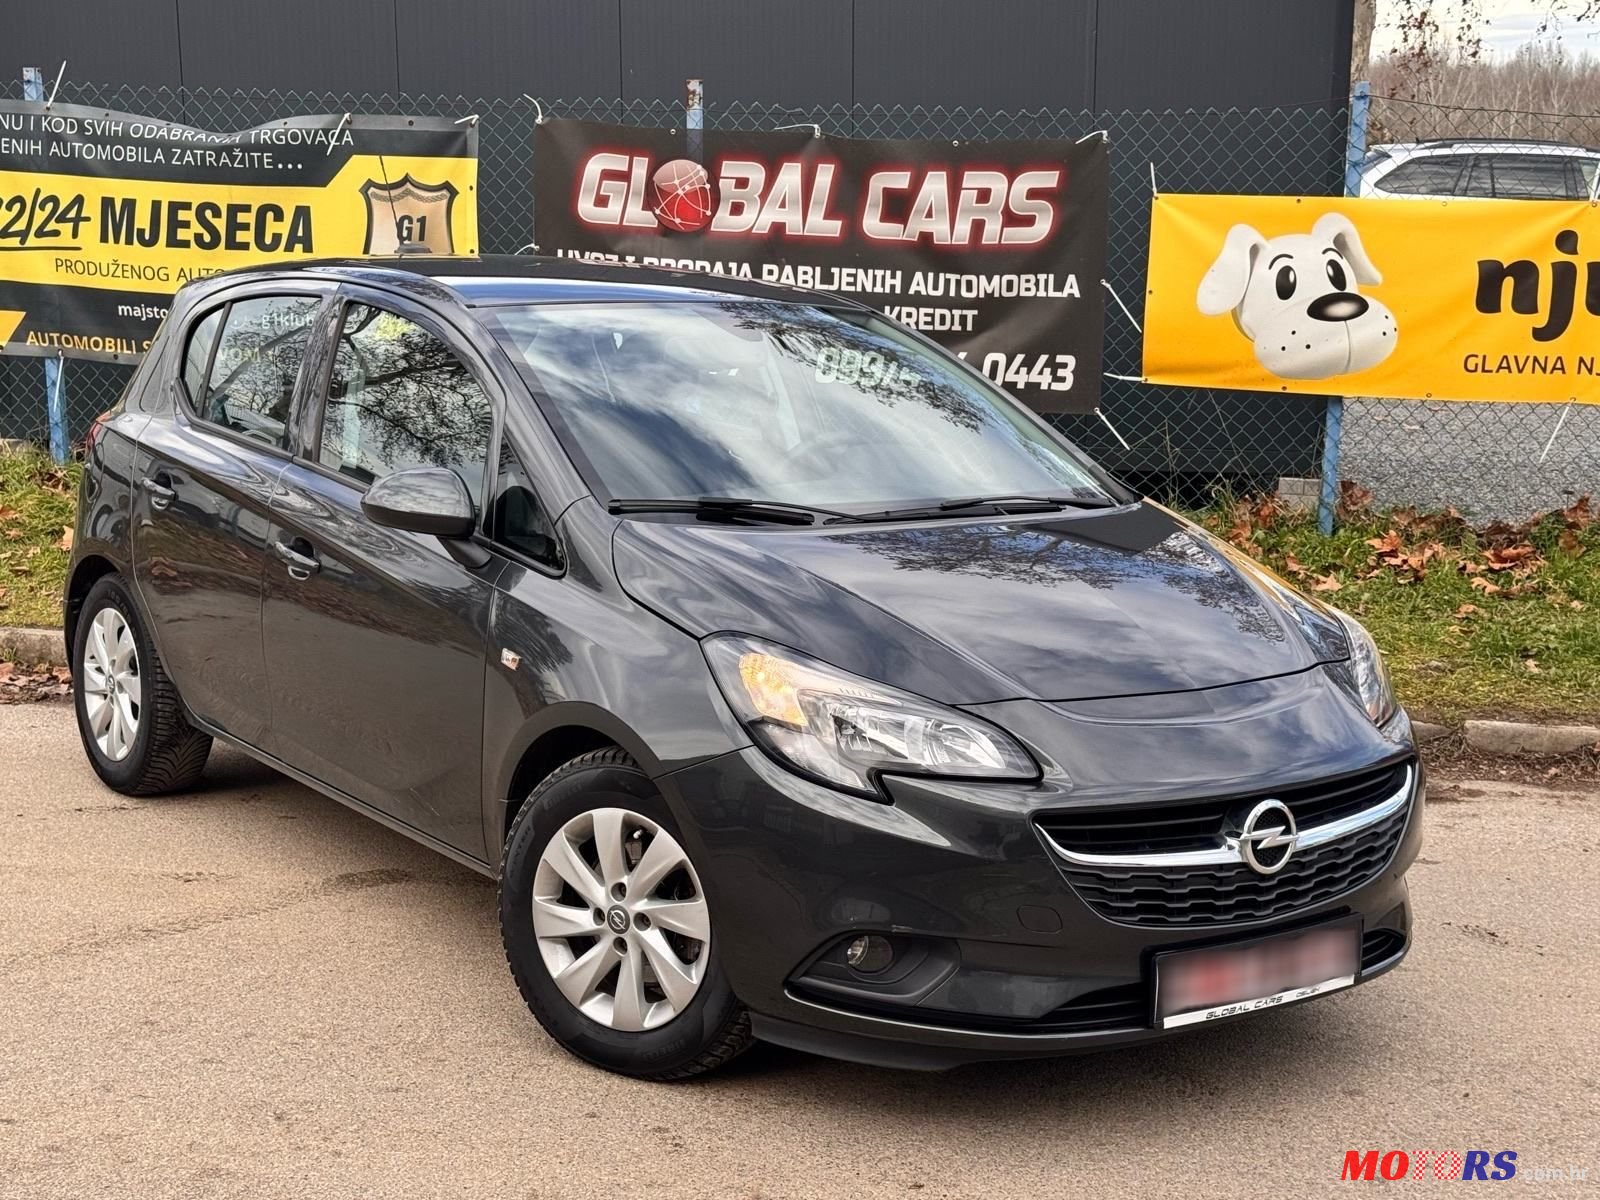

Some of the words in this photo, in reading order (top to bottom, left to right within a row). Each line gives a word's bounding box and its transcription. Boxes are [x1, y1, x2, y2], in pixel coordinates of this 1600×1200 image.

[30, 115, 34, 131] I
[42, 116, 78, 135] KOD
[84, 119, 123, 137] SVIH
[49, 141, 165, 164] AUTOMOBILA
[577, 152, 842, 237] GLOBAL
[862, 170, 1060, 245] CARS
[99, 196, 314, 254] MJESECA
[398, 214, 427, 245] G1
[55, 257, 170, 282] PRODUŽENOG
[762, 263, 902, 294] RABLJENIH
[908, 270, 1081, 299] AUTOMOBILA
[884, 305, 979, 332] KREDIT
[26, 330, 137, 355] AUTOMOBILI
[982, 351, 1076, 391] 0443
[1463, 354, 1567, 375] GLAVNA
[1576, 356, 1600, 376] N
[1206, 1003, 1250, 1020] GLOBAL
[1254, 995, 1283, 1009] CARS
